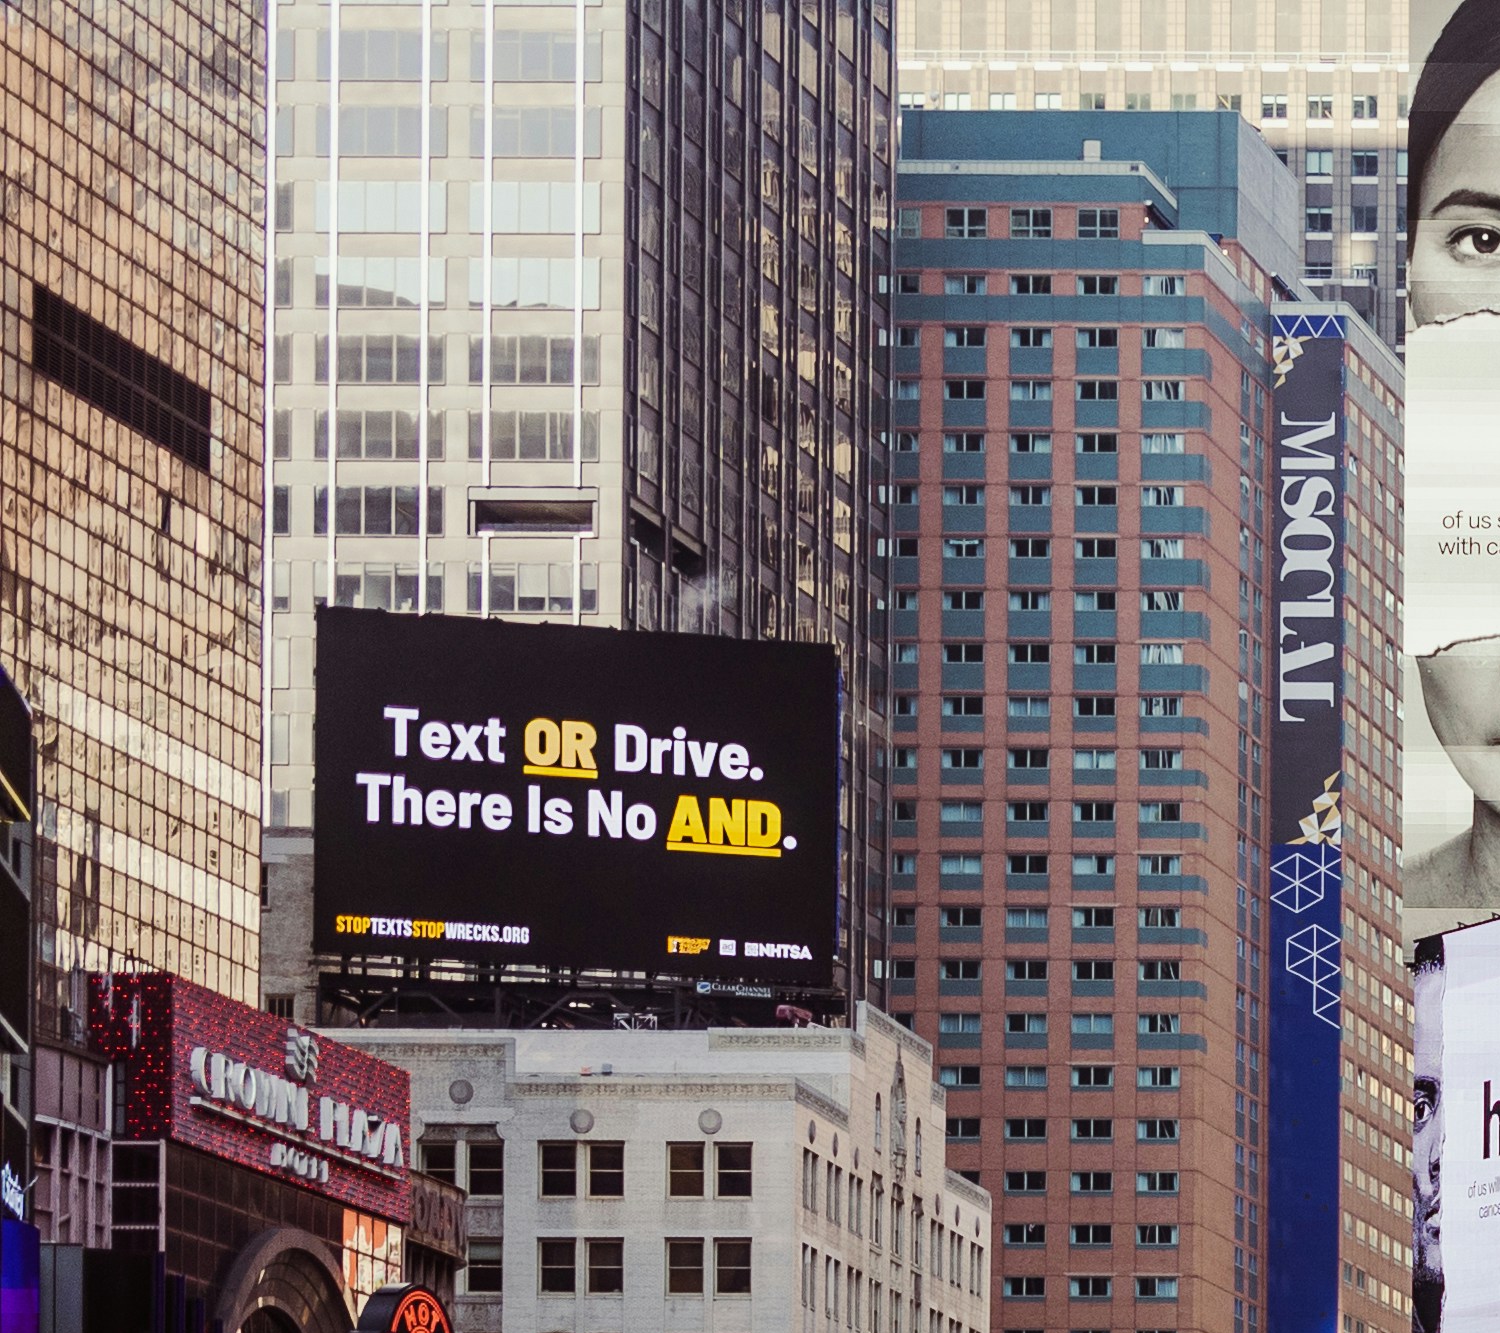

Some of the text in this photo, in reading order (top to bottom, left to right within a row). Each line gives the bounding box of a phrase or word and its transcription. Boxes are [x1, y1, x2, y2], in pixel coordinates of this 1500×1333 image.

[1443, 510, 1463, 529] of
[1469, 515, 1492, 529] us
[1438, 537, 1480, 555] with
[384, 706, 764, 781] Text OR Drive.
[356, 773, 797, 852] There Is No AND.
[336, 915, 530, 944] STOPTEXTSSTOPWRECKS.ORG
[758, 943, 813, 960] NHTSA
[1468, 1181, 1477, 1198] of
[1478, 1183, 1487, 1196] us
[1489, 1176, 1500, 1194] will
[404, 1302, 440, 1333] HOT
